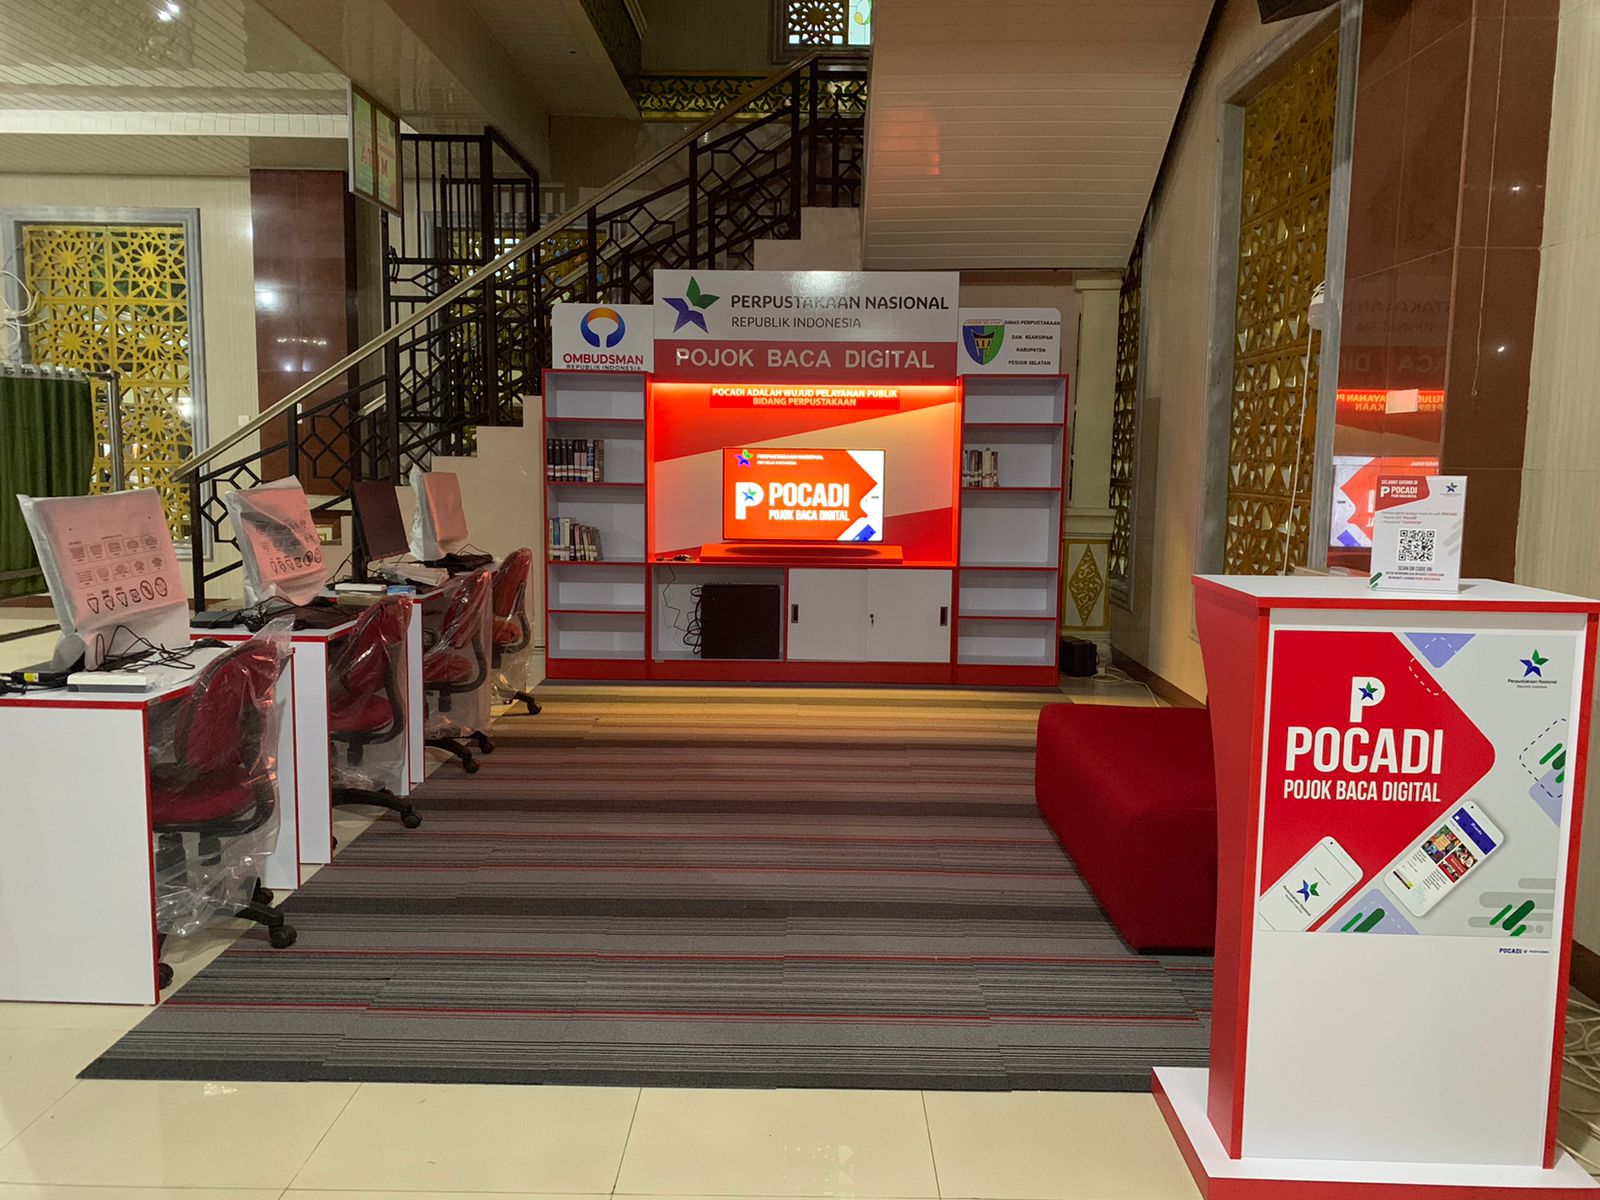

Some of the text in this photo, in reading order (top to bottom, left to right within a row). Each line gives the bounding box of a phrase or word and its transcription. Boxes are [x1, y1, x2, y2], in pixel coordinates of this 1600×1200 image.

[730, 295, 949, 310] PERPUSTAKAAN NASIONAL
[731, 316, 861, 329] REPUBLIK INDONESIA
[562, 353, 644, 365] OMBUDSMAN
[675, 347, 935, 369] POJOK BACA DIGITAL
[712, 388, 898, 399] POCADI ADALAH WUJUD PELAYANAN PUBLIK
[753, 398, 857, 407] BIDANG PERPUSTAKAAN
[769, 482, 850, 507] POCADI
[1391, 486, 1418, 494] POCADI
[735, 482, 764, 520] P
[768, 509, 850, 522] POJOK BACA DIGITAL
[1350, 676, 1386, 723] P
[1285, 726, 1444, 775] POCADI
[1283, 779, 1441, 803] POJOK BACA DIGITAL
